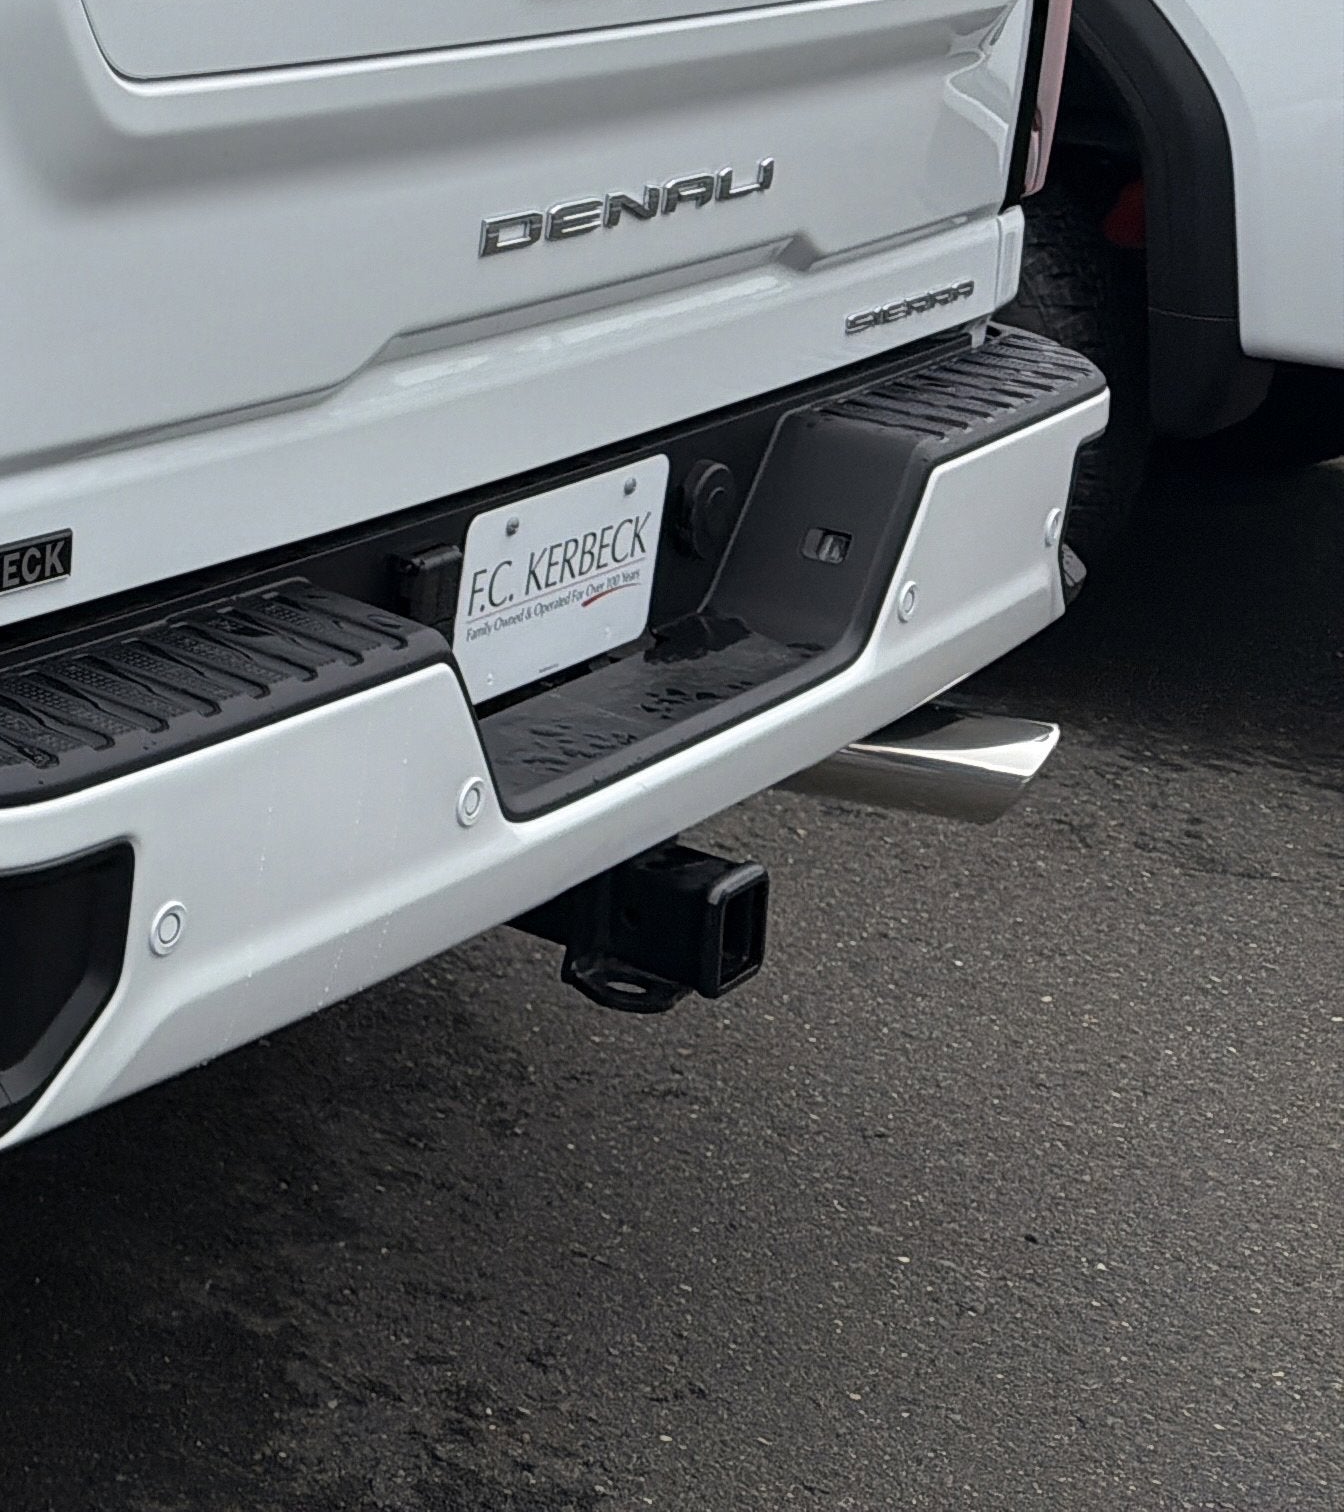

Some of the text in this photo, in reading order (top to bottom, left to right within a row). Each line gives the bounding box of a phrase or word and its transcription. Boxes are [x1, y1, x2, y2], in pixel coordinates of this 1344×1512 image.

[478, 157, 774, 258] DENALI
[844, 280, 975, 334] SIERRA
[466, 570, 640, 642] Family Owned & Operated For Over 100 Years
[467, 511, 652, 616] F.C. KERBECK
